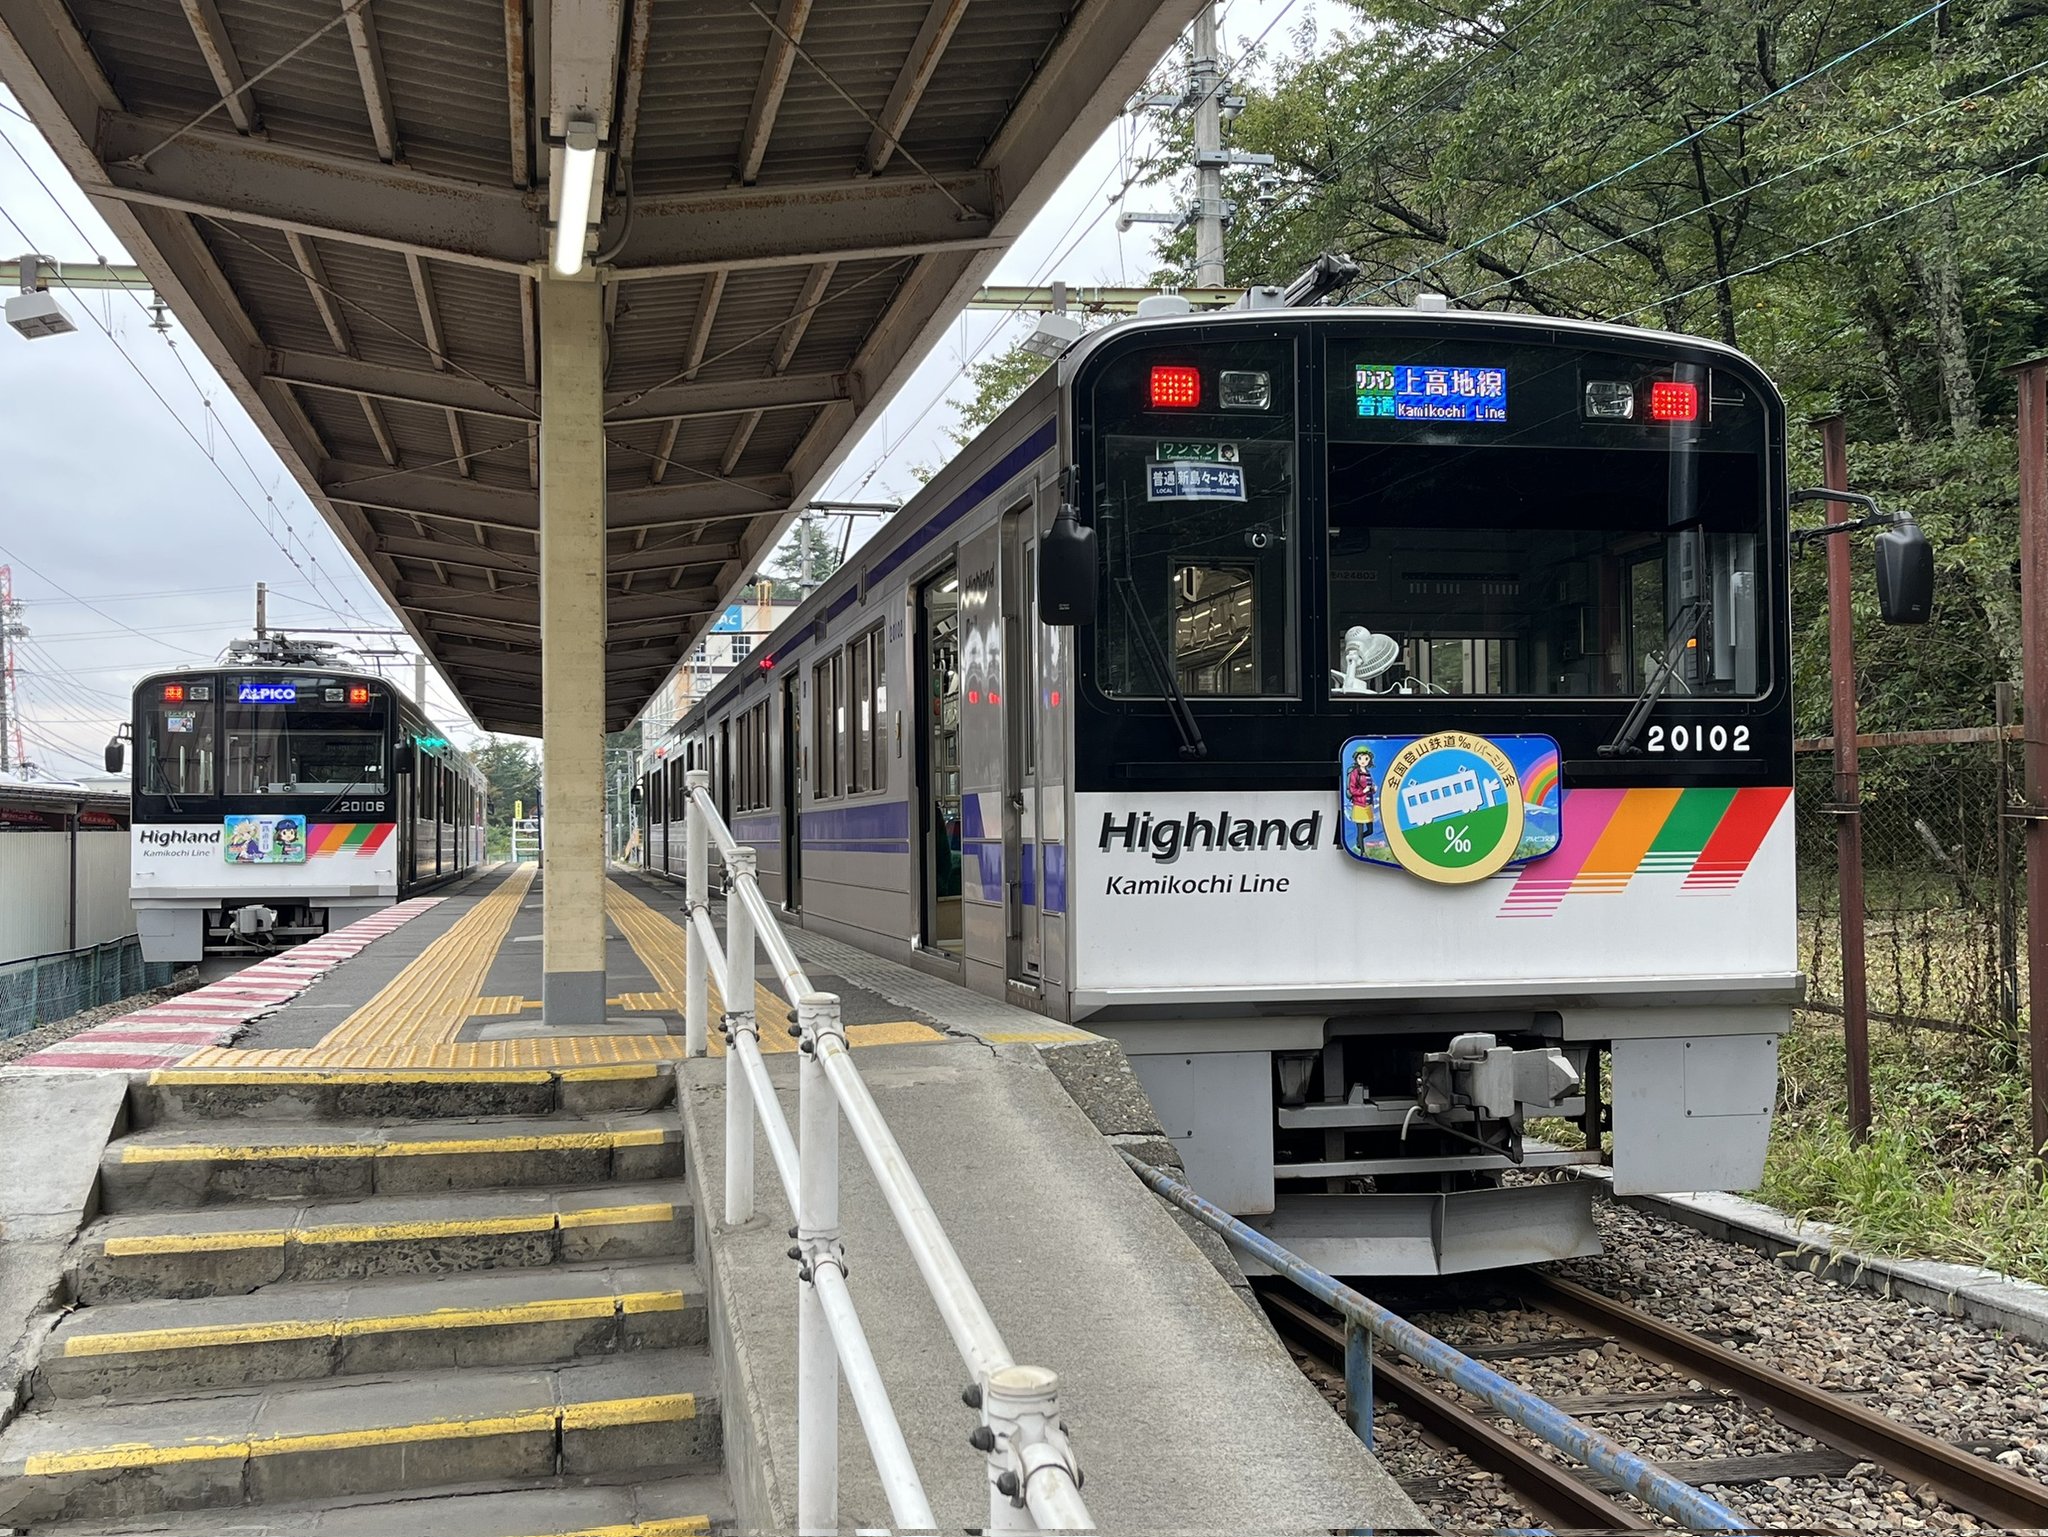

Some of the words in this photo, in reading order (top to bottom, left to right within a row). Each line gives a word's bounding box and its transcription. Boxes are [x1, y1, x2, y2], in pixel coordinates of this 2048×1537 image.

[1398, 369, 1502, 397] 上高地線
[1357, 396, 1395, 416] 普通
[1398, 403, 1466, 418] Kamikochi
[1475, 405, 1506, 419] Line
[1163, 443, 1216, 455] ワンマン
[1153, 471, 1175, 487] 普通
[239, 688, 296, 700] ALPICO
[1647, 725, 1750, 751] 20102
[341, 801, 385, 812] 20106
[140, 830, 221, 847] Highland
[1098, 810, 1322, 863] Highland
[143, 849, 189, 857] Kamikochi
[191, 849, 211, 857] Line
[1106, 874, 1233, 895] Kamikochi
[1239, 874, 1290, 893] Line
